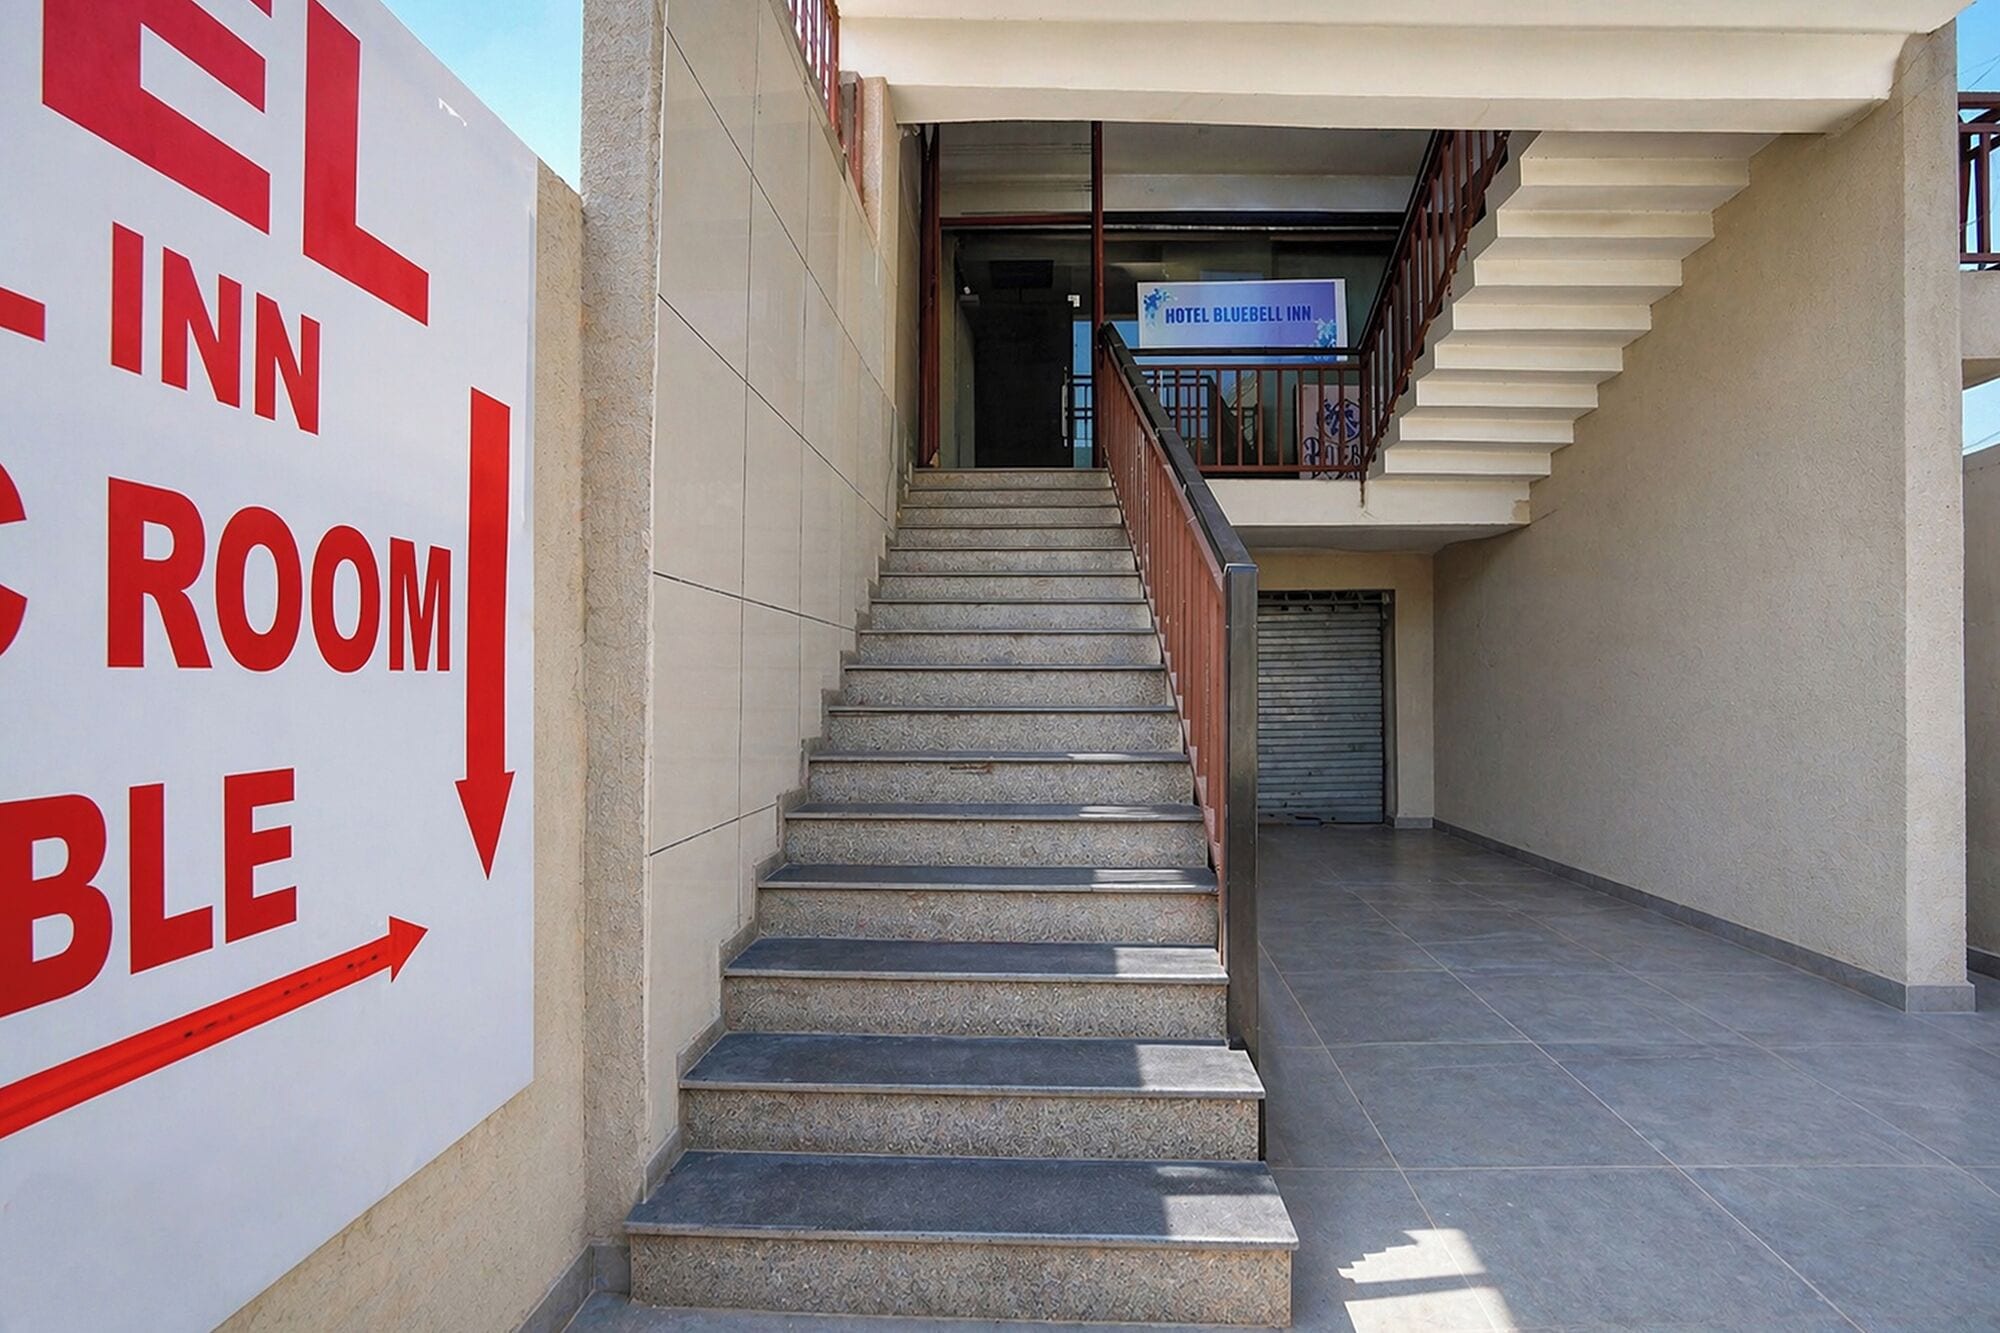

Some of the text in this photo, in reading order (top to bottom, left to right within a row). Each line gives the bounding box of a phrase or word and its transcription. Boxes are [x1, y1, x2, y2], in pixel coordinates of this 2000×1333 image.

[110, 221, 321, 436] INN
[1165, 305, 1312, 324] HOTEL BLUEBELL INN
[106, 476, 452, 674] ROOM
[0, 767, 298, 1019] BLE
